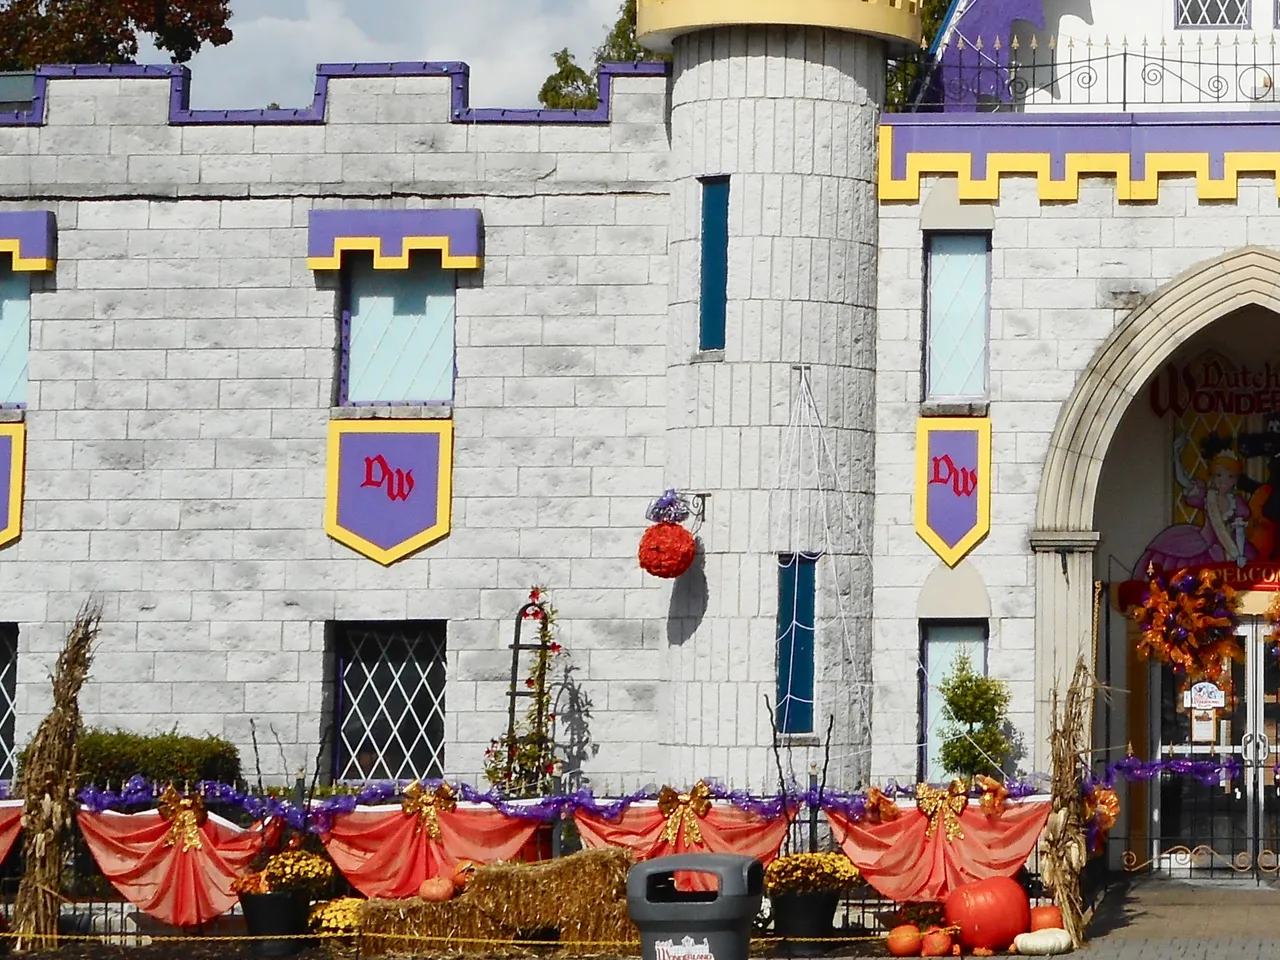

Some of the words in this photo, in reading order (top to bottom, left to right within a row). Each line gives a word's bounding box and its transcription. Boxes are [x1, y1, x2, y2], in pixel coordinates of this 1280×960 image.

[1200, 360, 1280, 389] Dutch
[360, 454, 415, 501] DW
[928, 454, 978, 497] DW
